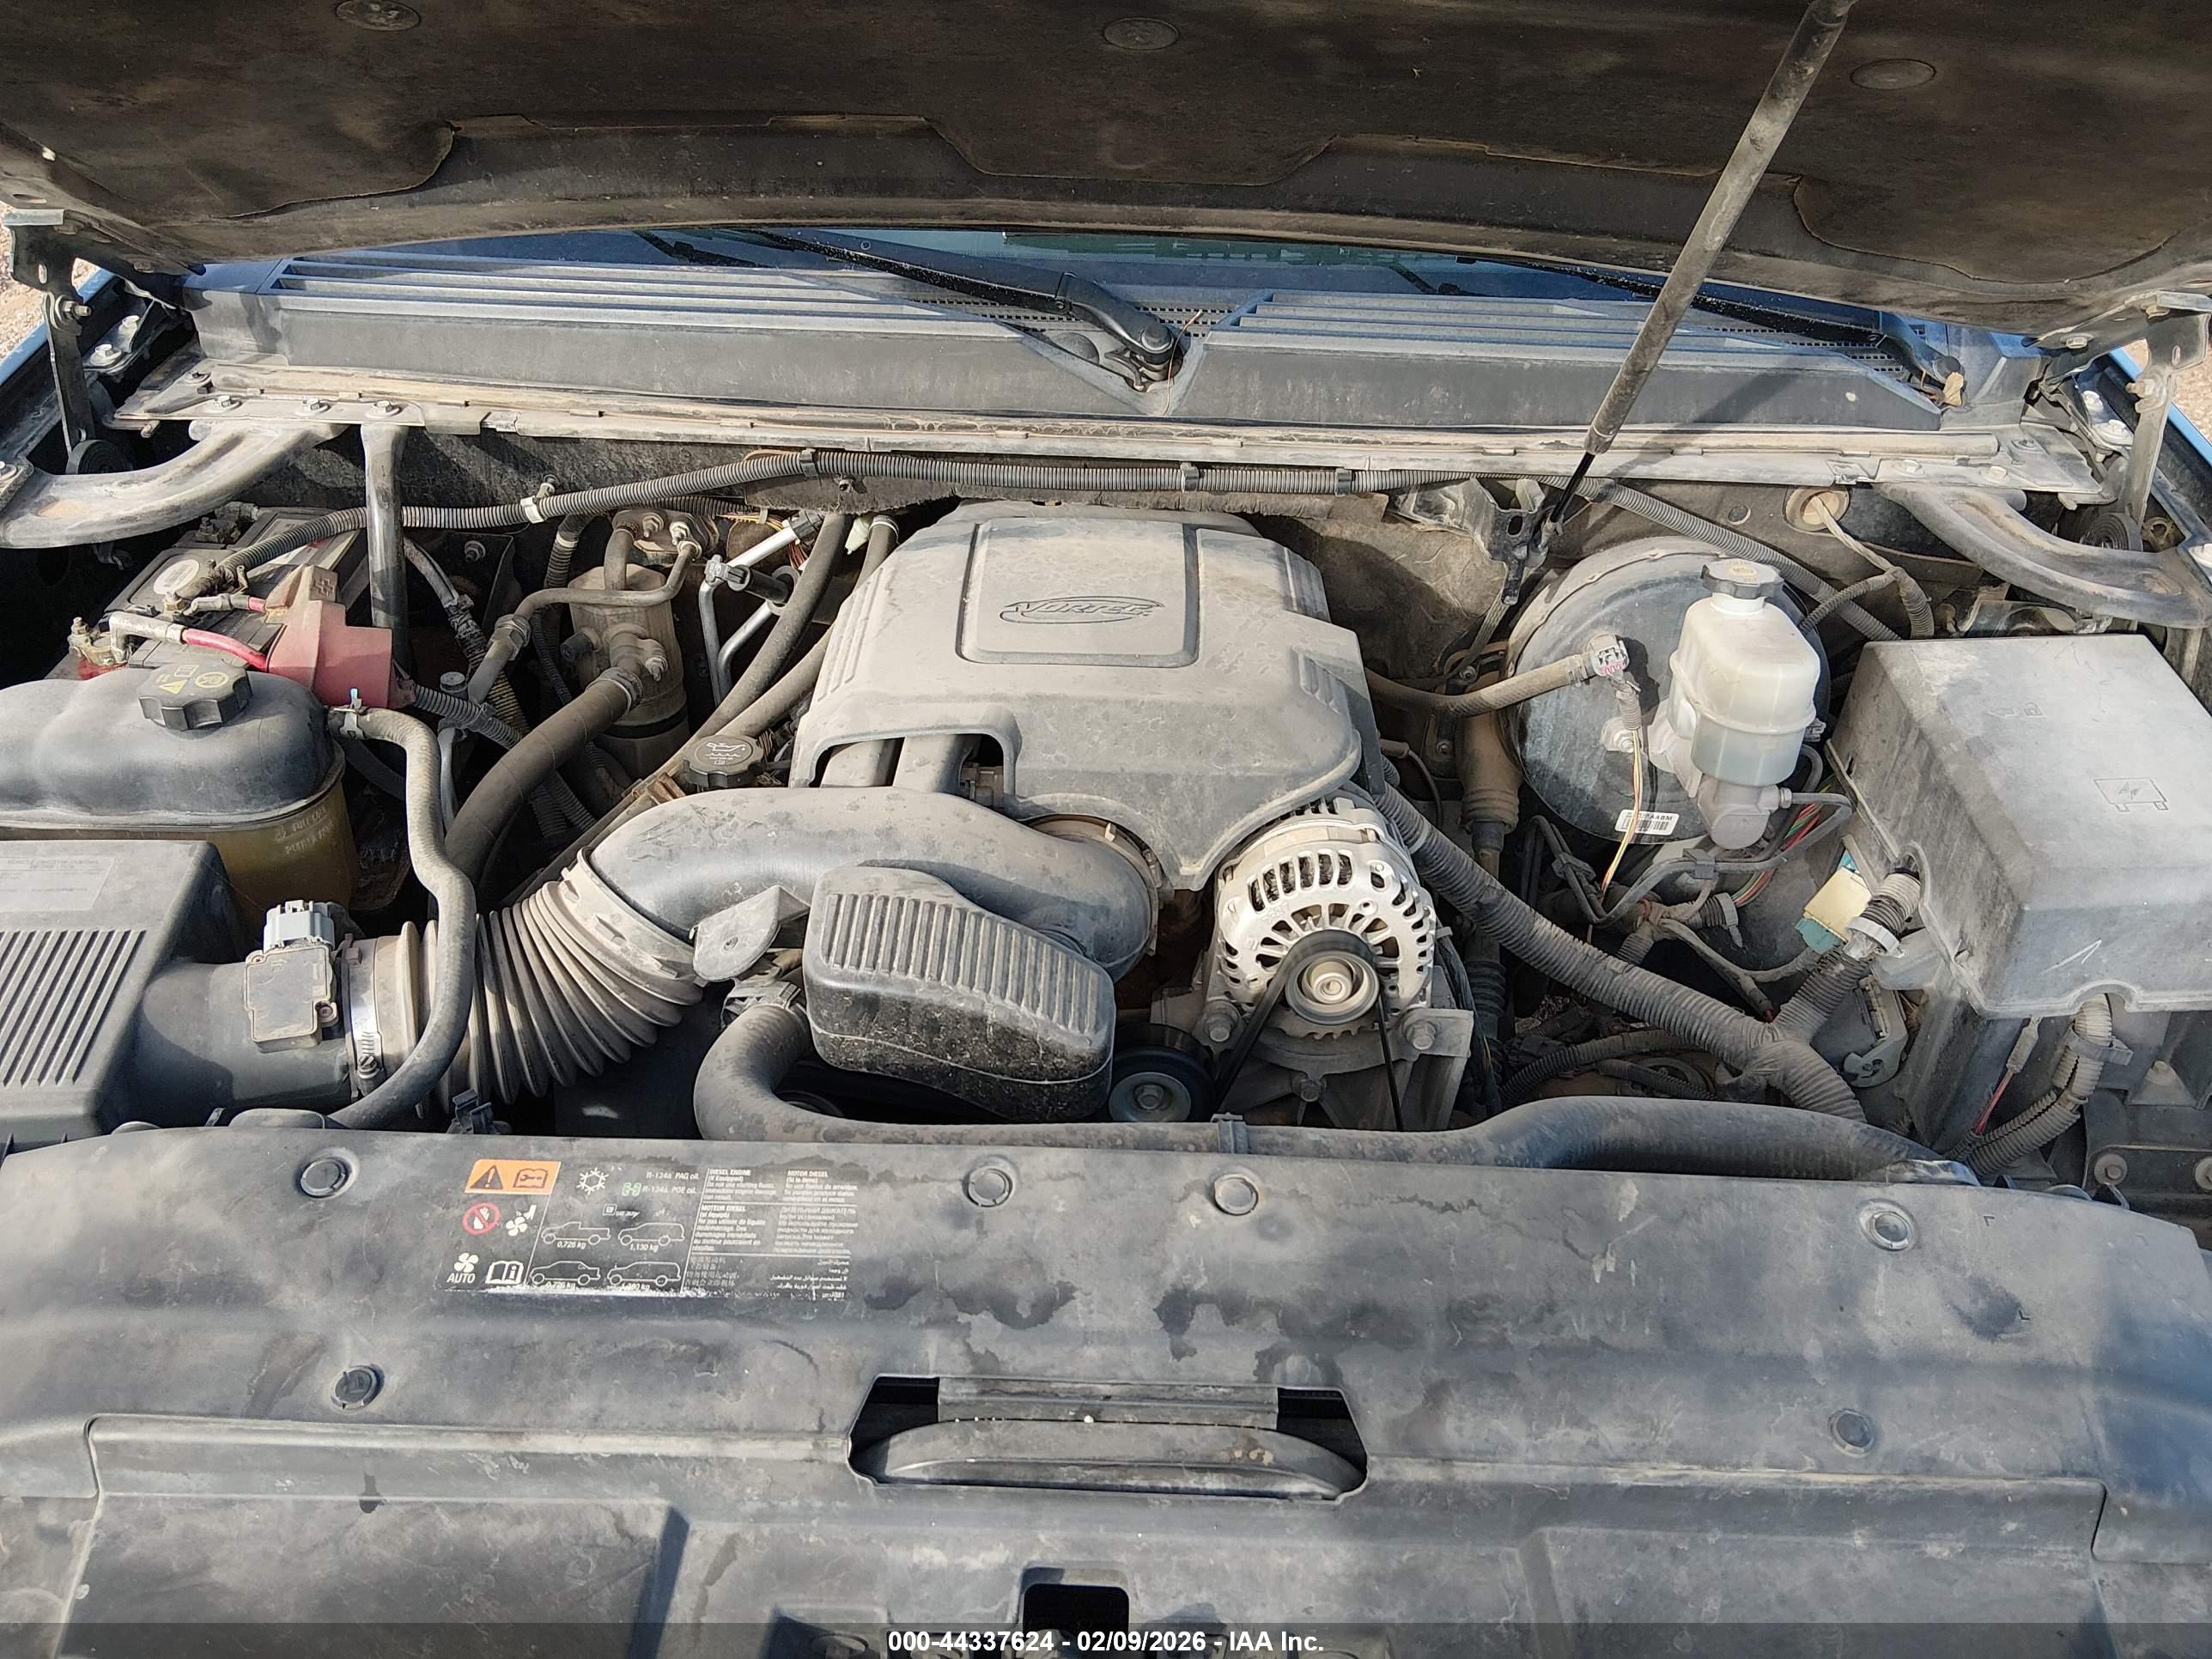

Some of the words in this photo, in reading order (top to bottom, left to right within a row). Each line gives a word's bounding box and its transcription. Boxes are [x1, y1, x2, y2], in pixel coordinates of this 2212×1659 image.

[577, 1242, 586, 1250] kg
[649, 1244, 659, 1253] kg
[447, 1273, 476, 1284] AUTO
